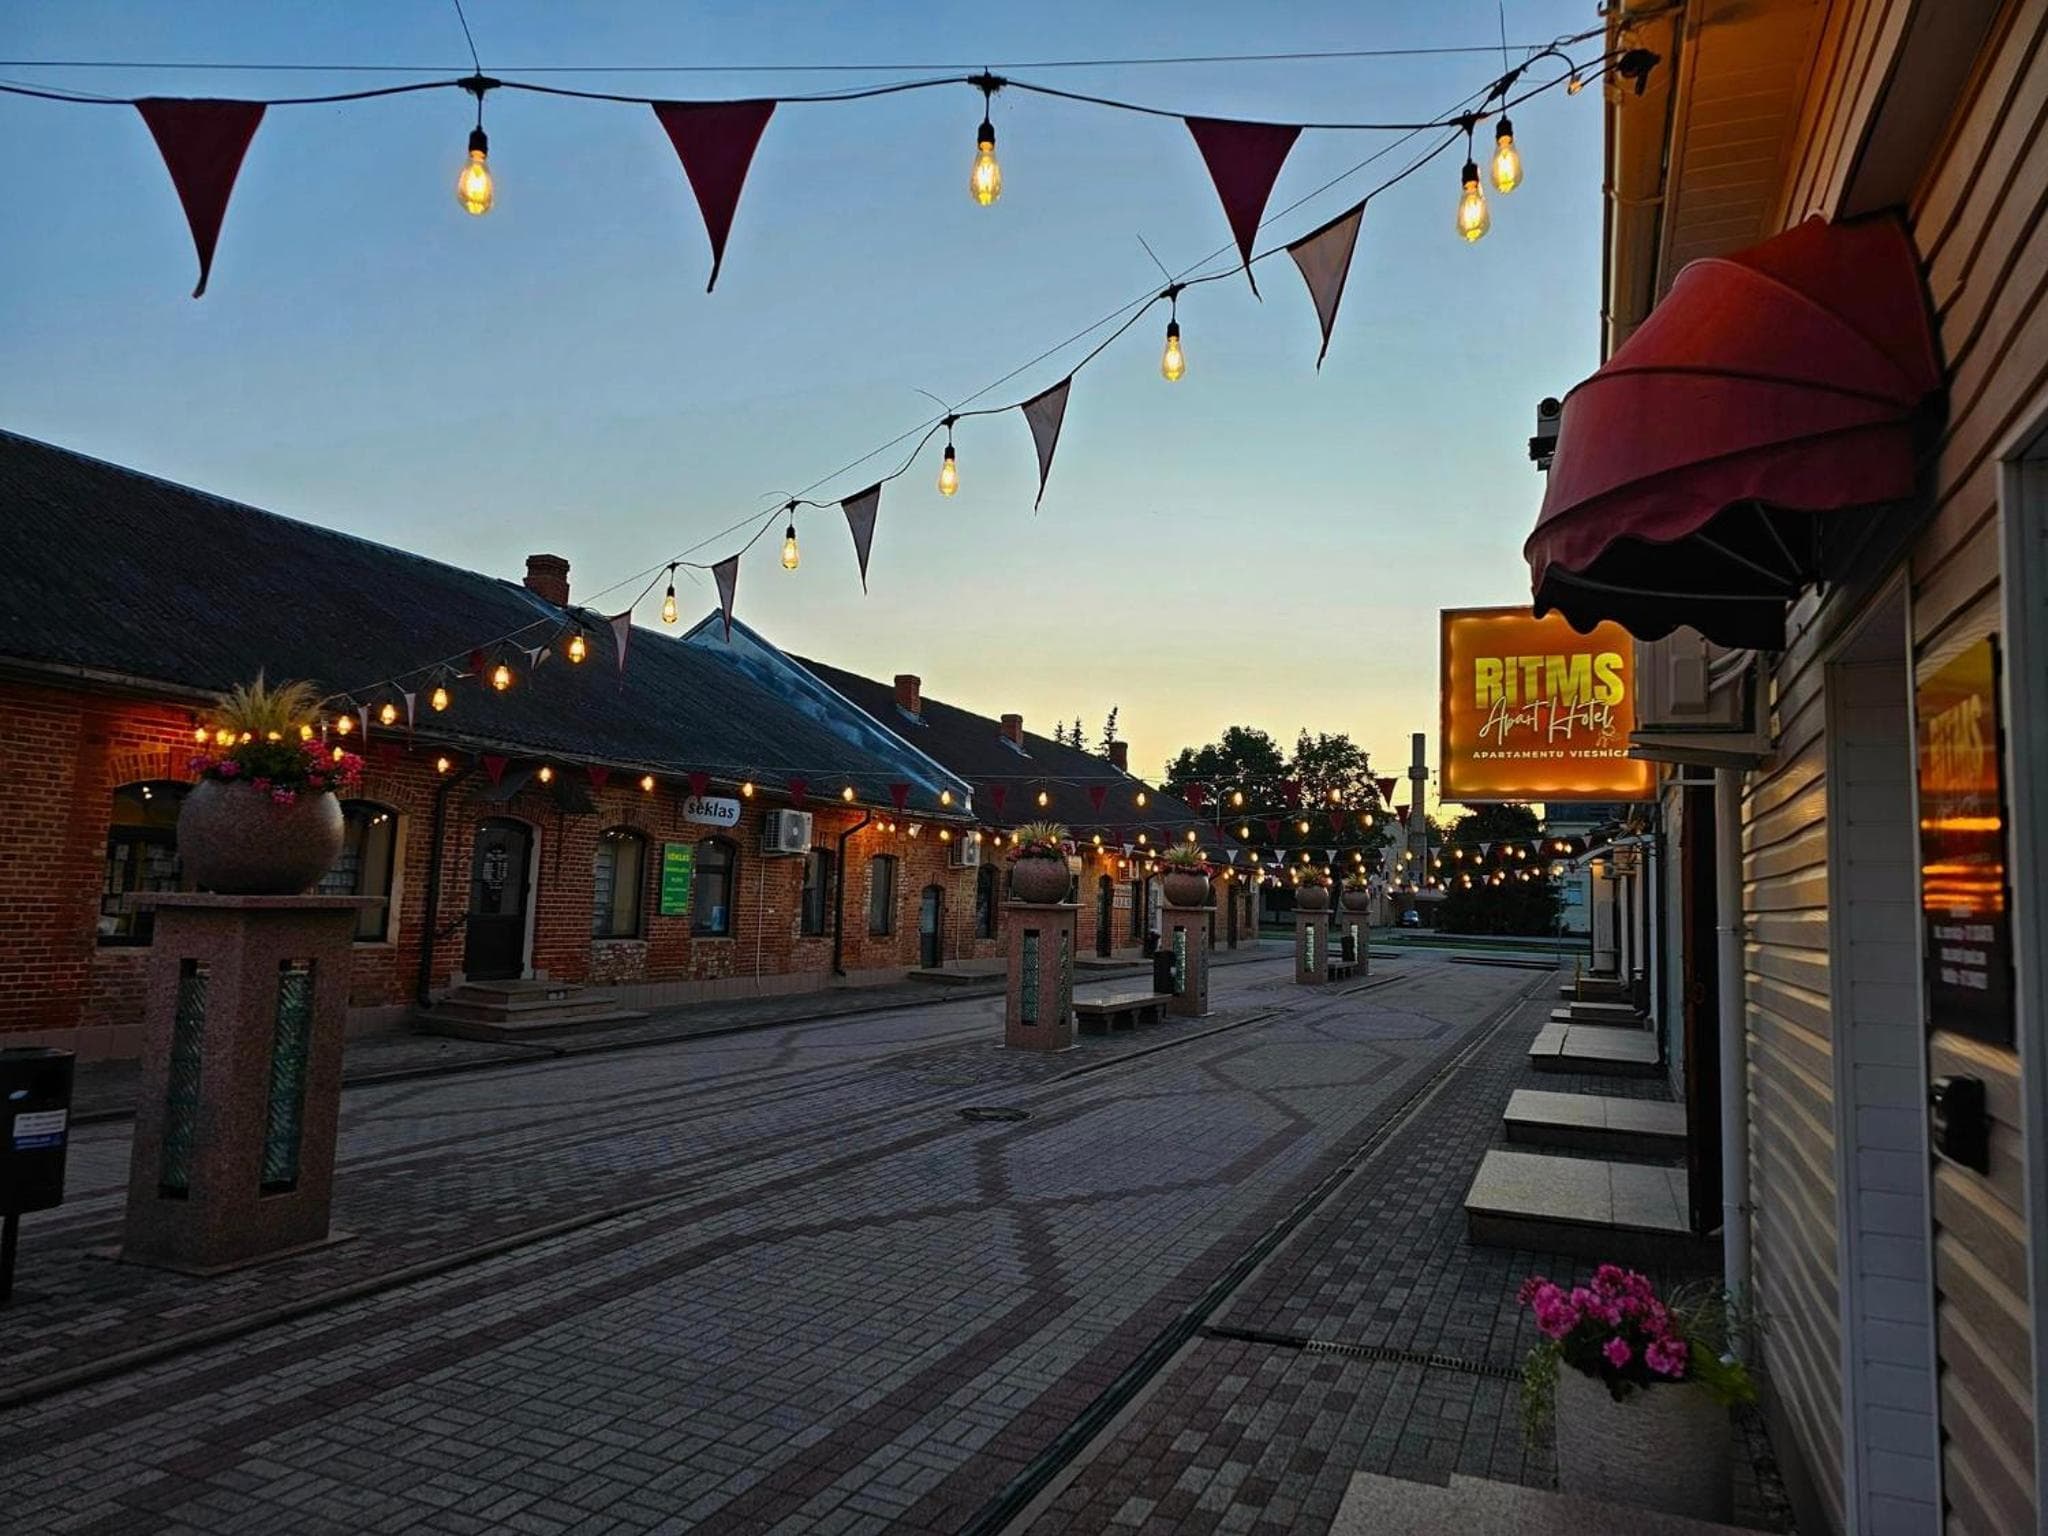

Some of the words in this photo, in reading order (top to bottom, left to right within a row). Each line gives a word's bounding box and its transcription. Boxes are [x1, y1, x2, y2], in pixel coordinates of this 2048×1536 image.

[1475, 652, 1625, 709] RITMS
[1479, 696, 1549, 745] Apart
[1548, 695, 1614, 743] Hotel
[1472, 750, 1565, 759] APARTAMENTU
